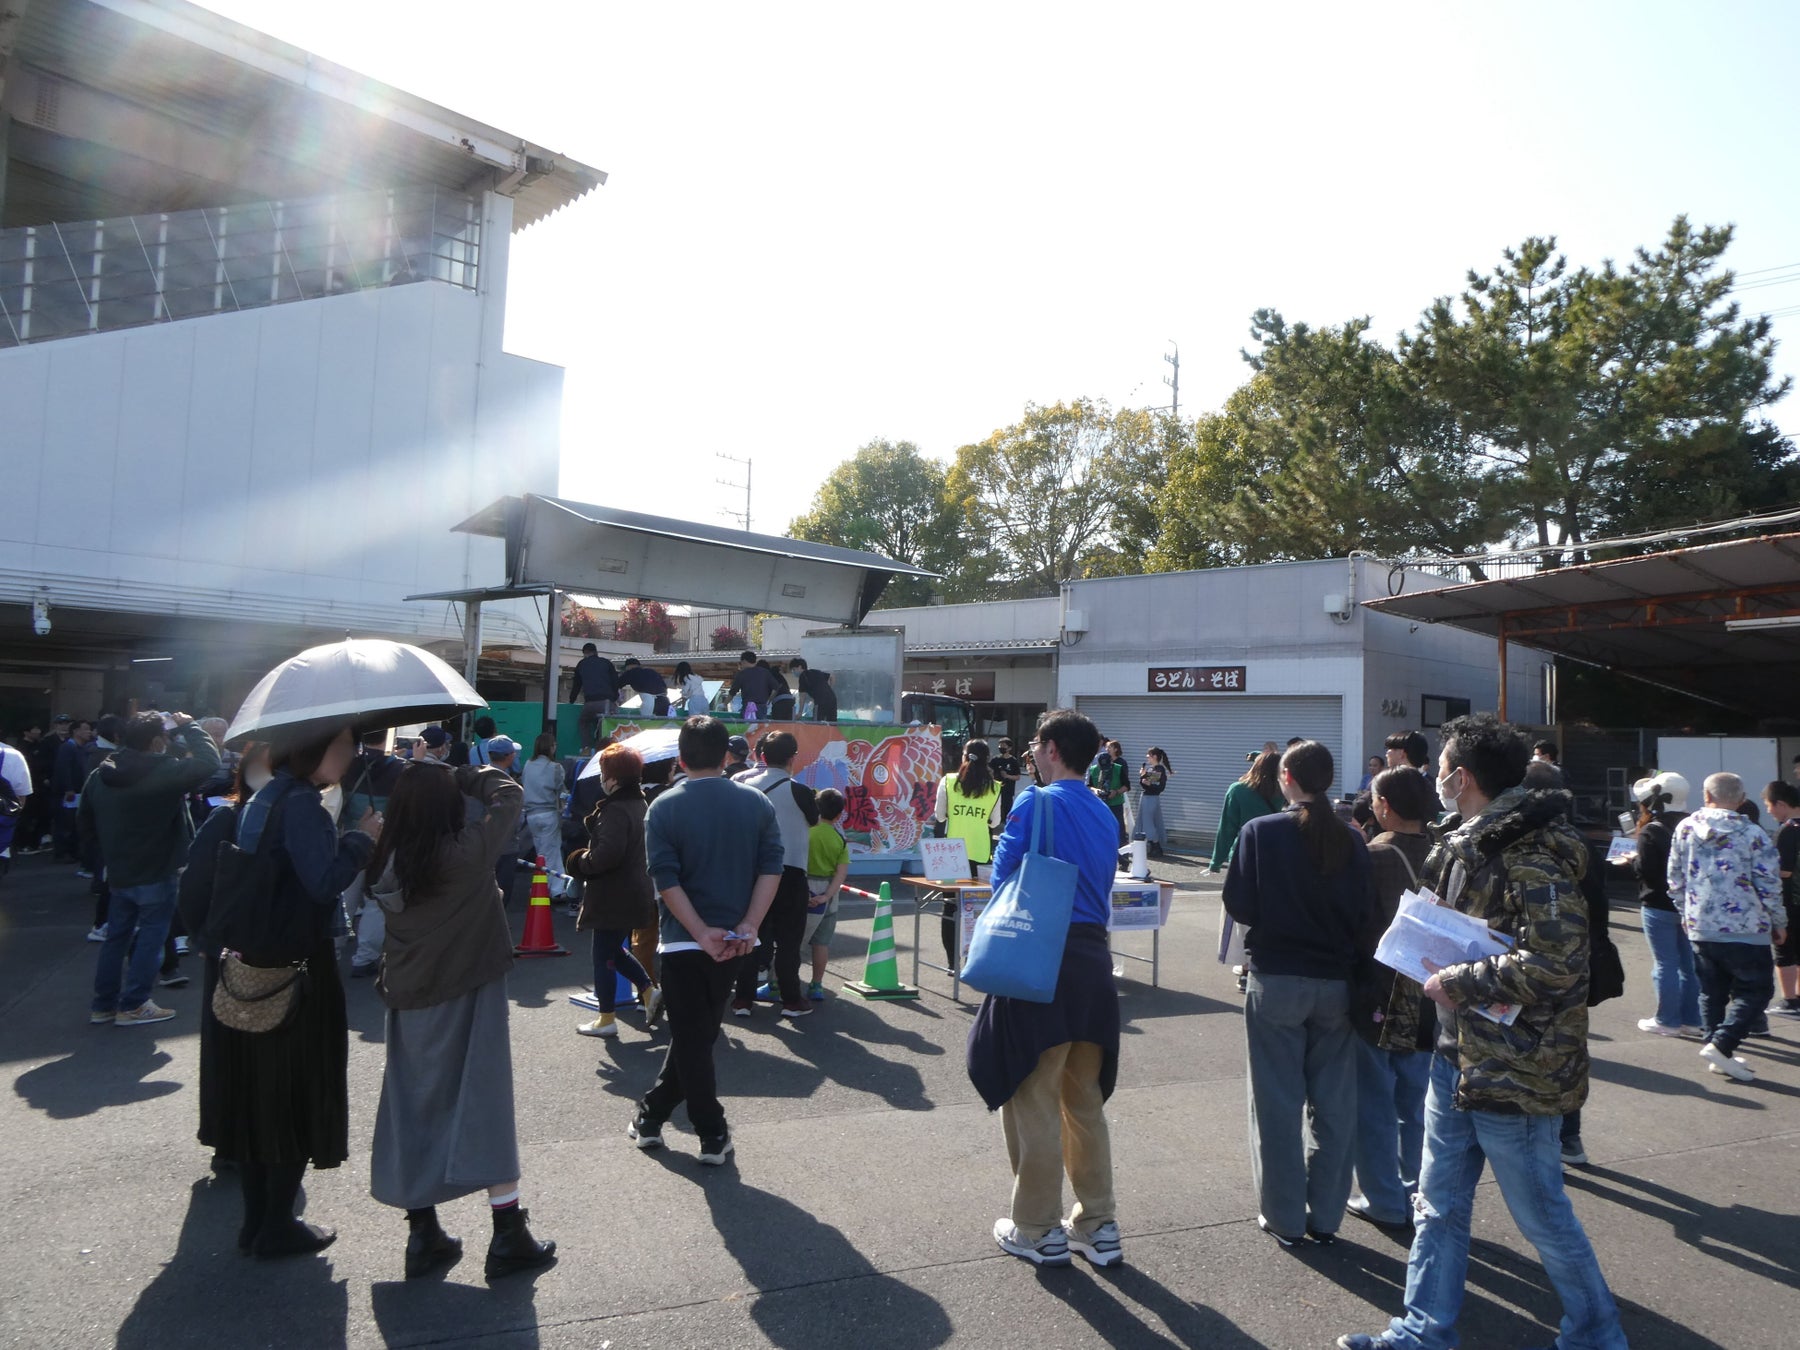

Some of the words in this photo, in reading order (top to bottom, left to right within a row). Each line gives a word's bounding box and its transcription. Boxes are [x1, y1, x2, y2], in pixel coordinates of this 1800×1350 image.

[1155, 671, 1239, 688] うどん・そば
[953, 805, 987, 819] STAFF
